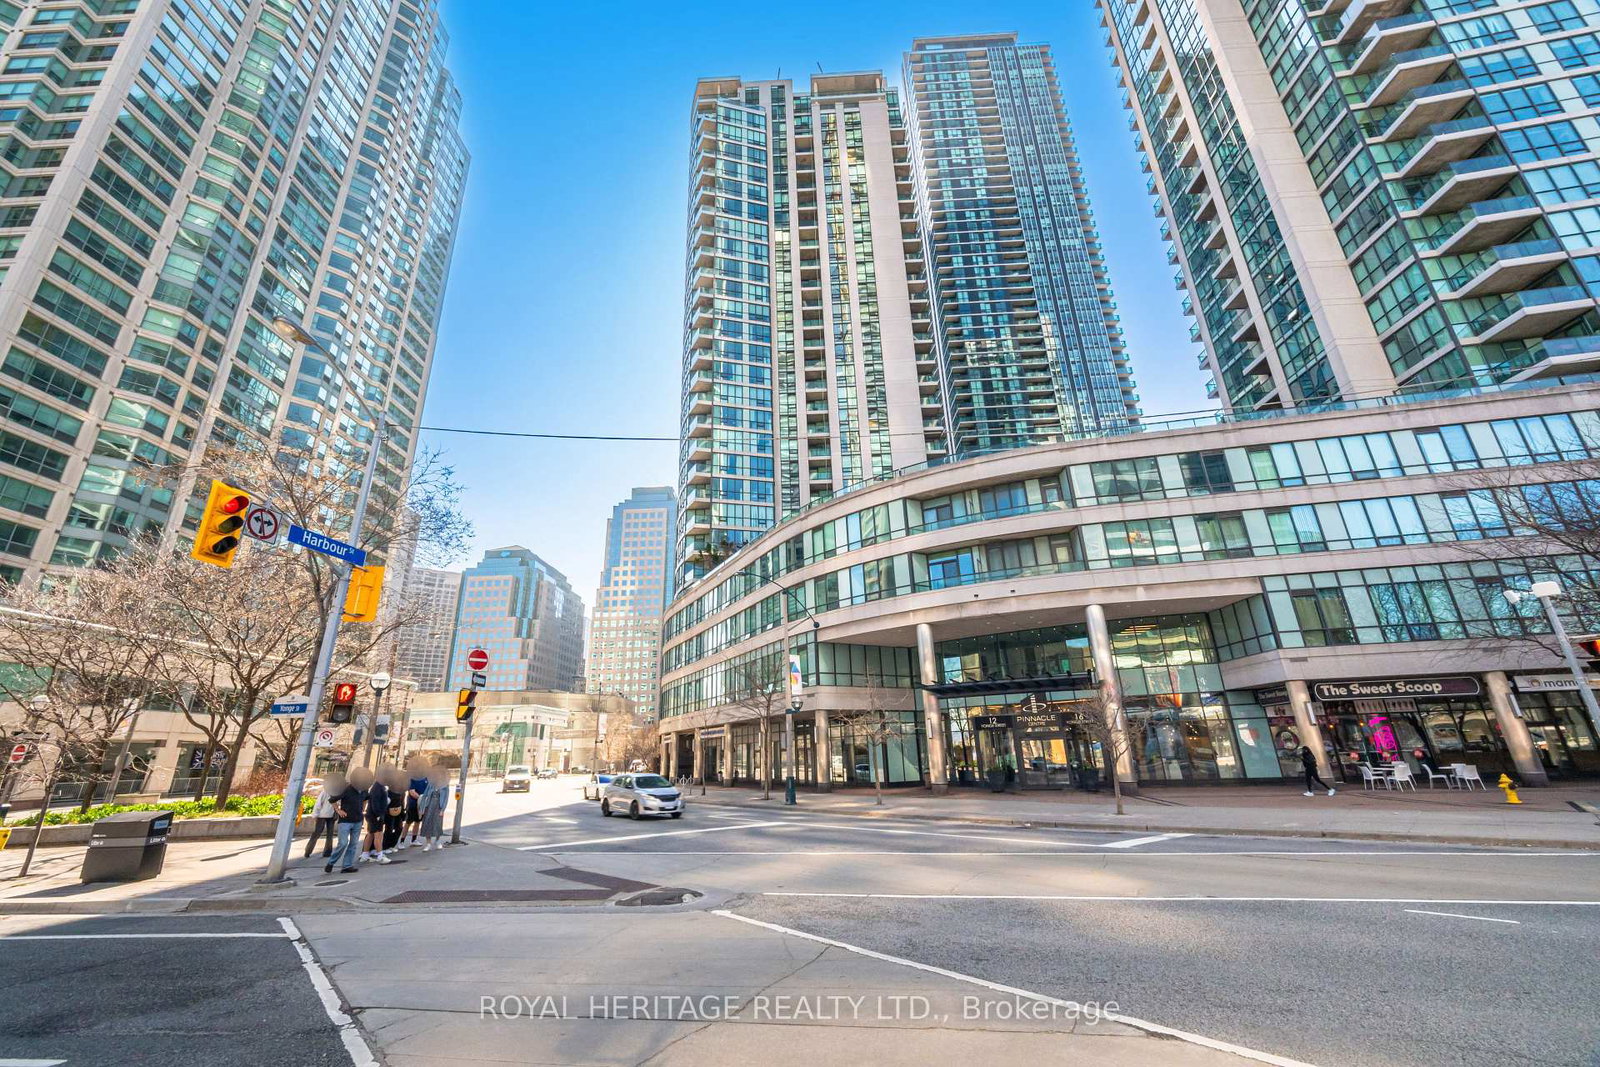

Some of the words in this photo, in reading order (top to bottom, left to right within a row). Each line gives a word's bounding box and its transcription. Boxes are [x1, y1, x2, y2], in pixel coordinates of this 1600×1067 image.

[302, 531, 348, 556] Harbour
[1320, 684, 1347, 696] The
[1350, 682, 1392, 695] Sweet
[1395, 681, 1442, 694] Scoop
[1544, 680, 1579, 688] mam
